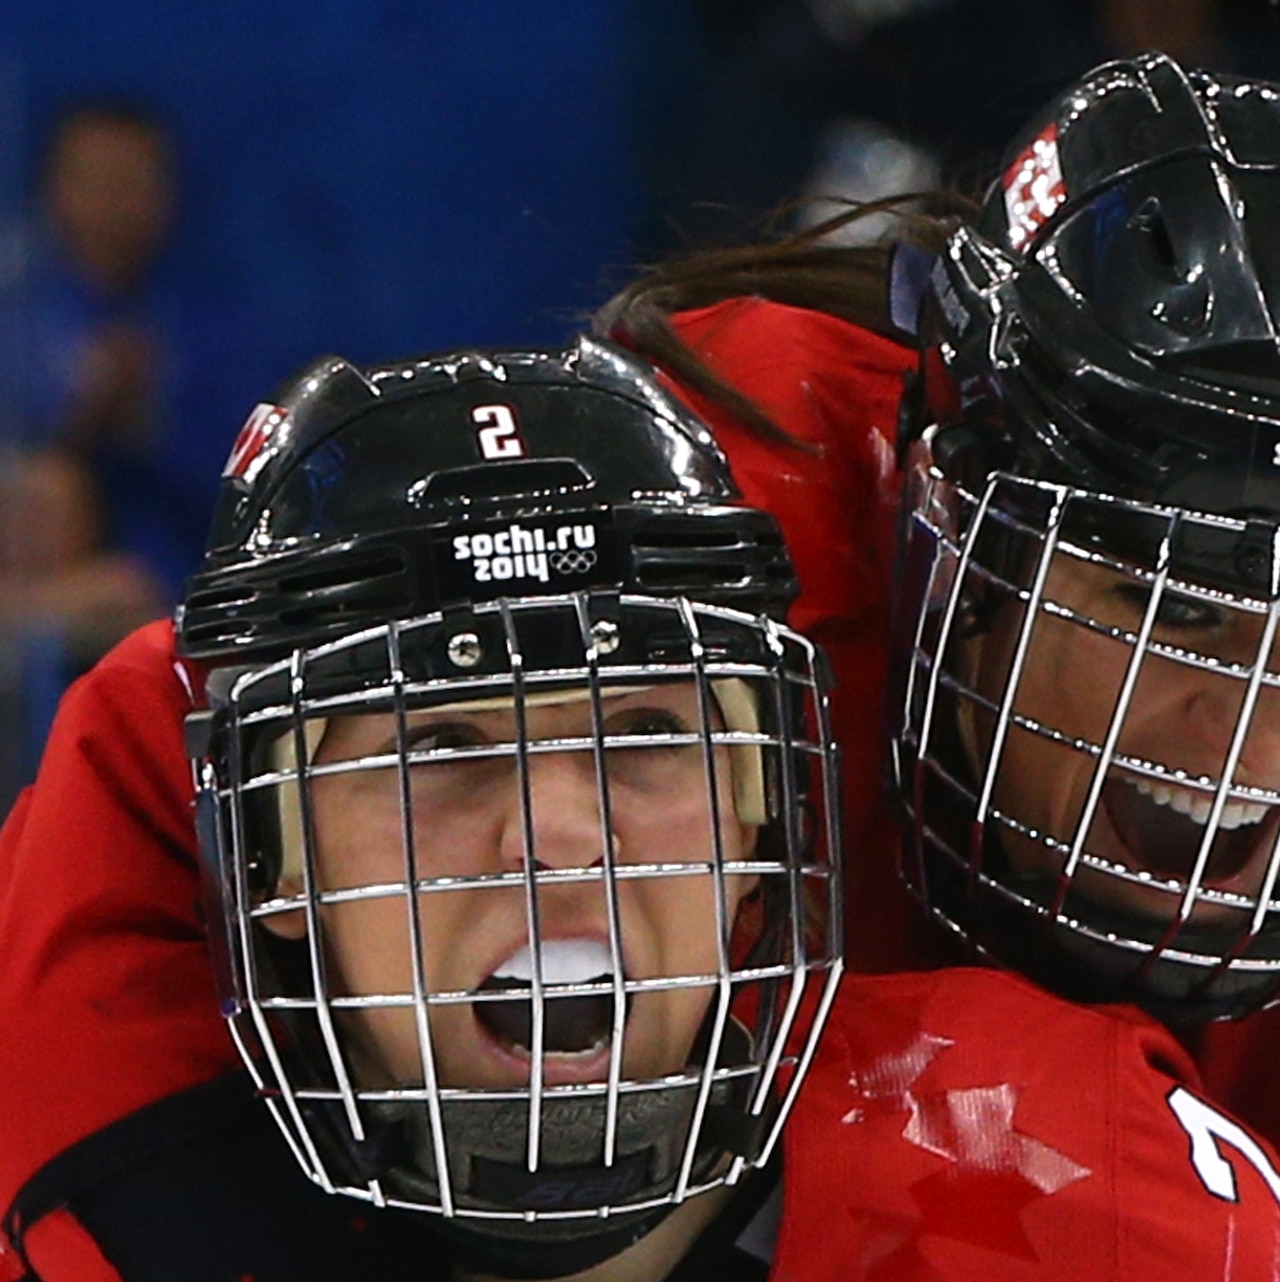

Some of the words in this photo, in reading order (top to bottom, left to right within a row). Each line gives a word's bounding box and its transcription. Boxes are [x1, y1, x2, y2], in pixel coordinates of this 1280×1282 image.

[472, 405, 523, 460] 2
[453, 525, 595, 559] sochi.ru
[474, 553, 550, 582] 2014
